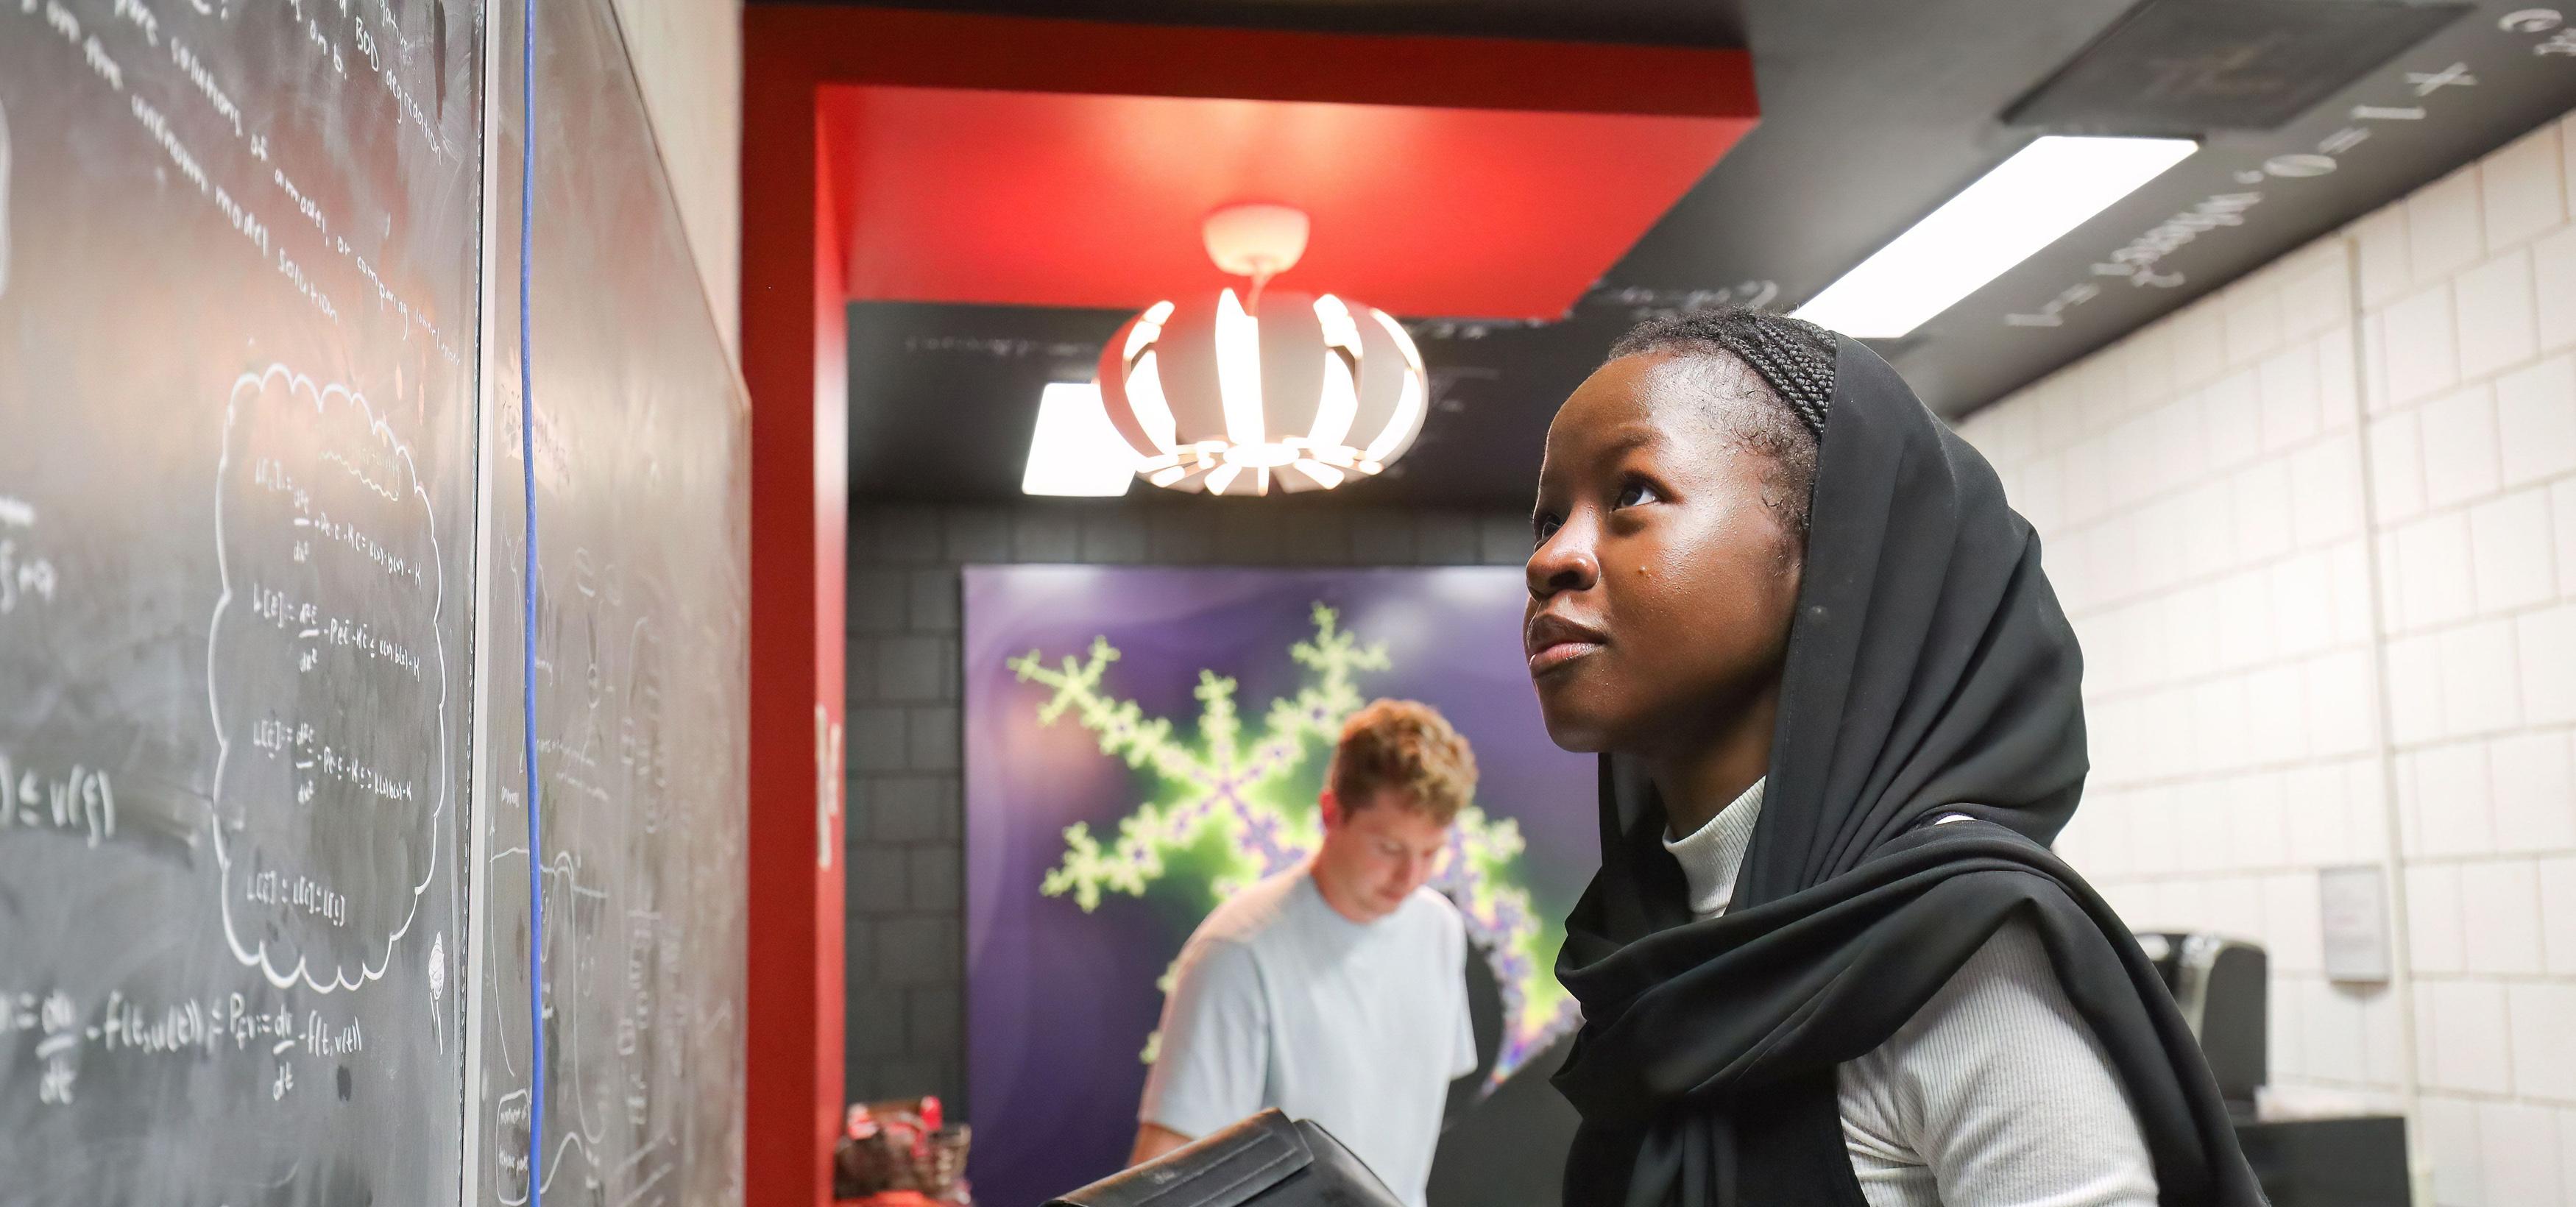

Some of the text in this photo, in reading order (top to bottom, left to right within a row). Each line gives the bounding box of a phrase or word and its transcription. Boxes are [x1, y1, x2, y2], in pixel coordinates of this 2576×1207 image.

[355, 15, 379, 71] BOD
[216, 183, 270, 259] model
[277, 246, 339, 326] solution
[337, 235, 351, 255] or
[357, 256, 408, 341] comparing
